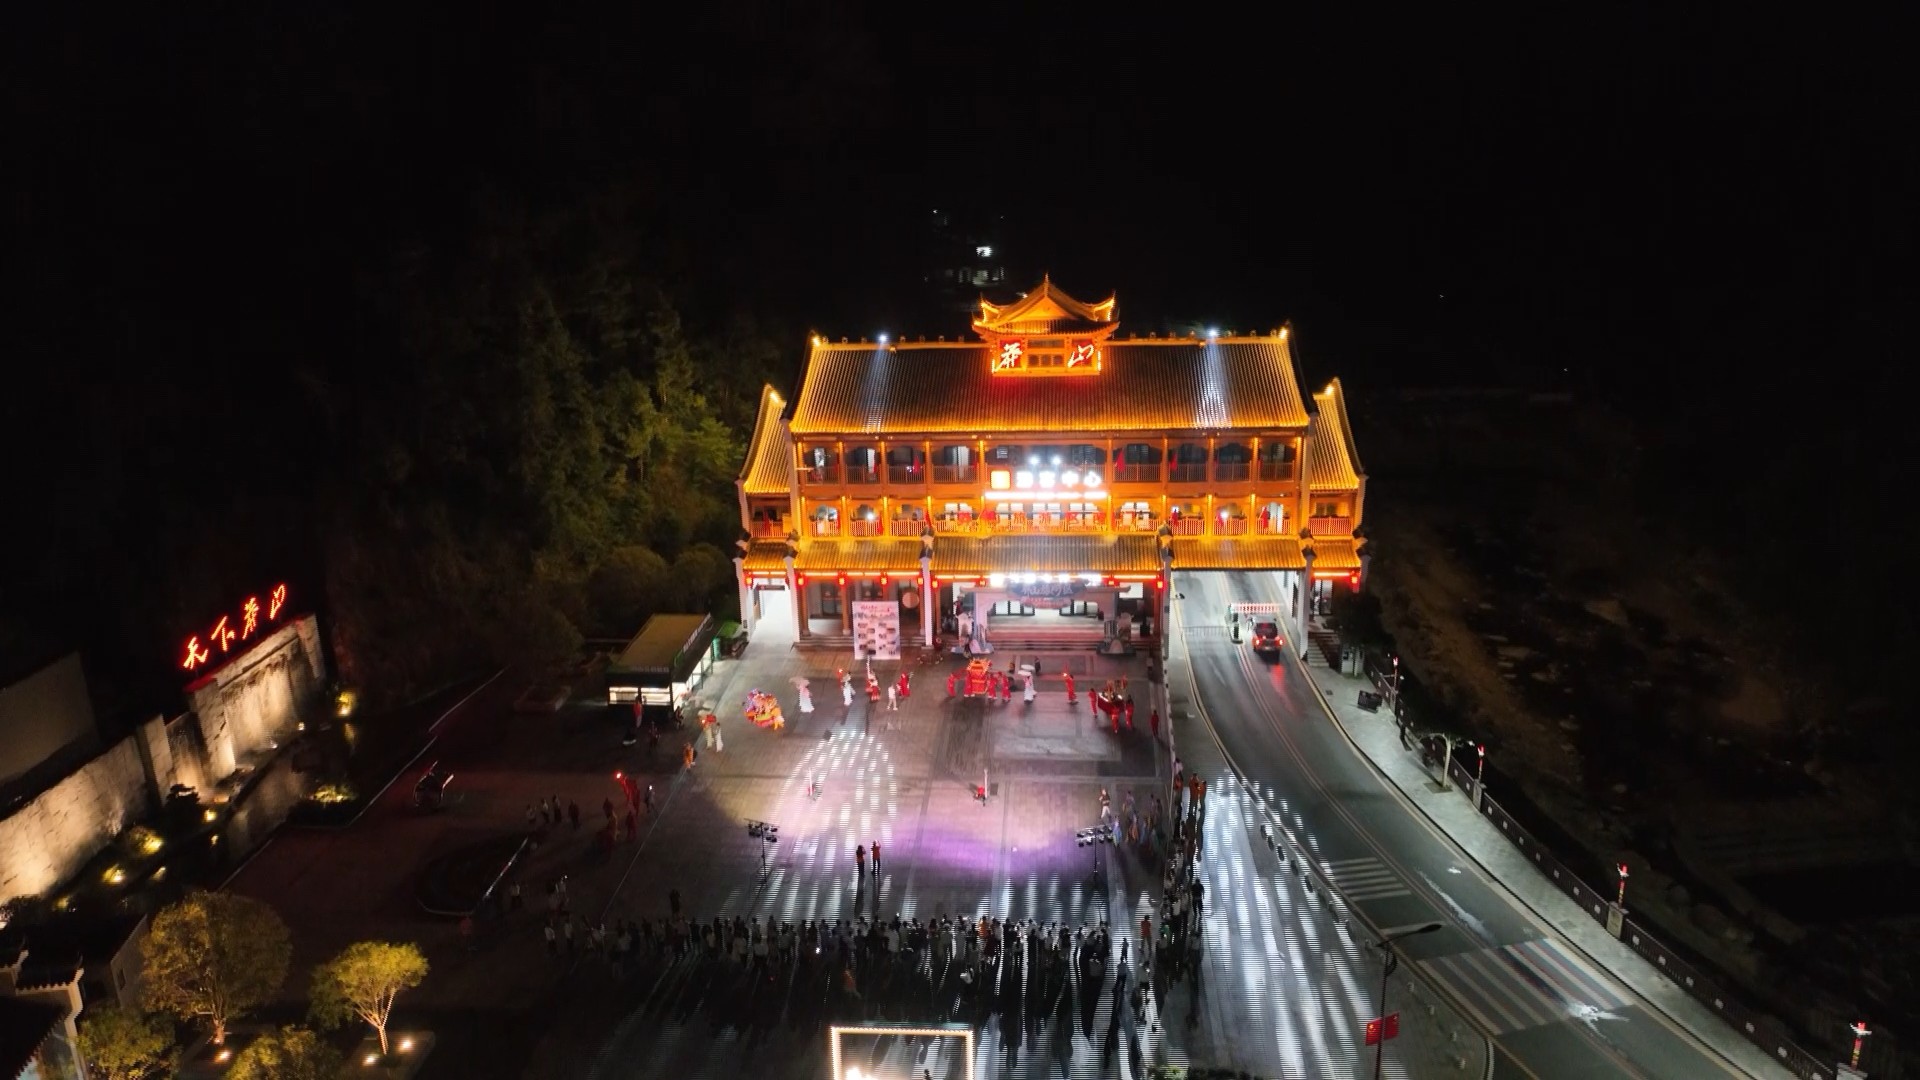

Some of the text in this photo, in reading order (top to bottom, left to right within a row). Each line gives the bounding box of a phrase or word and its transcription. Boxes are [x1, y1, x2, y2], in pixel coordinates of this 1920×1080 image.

[992, 342, 1094, 371] 莽山
[183, 583, 286, 670] 天下莽山
